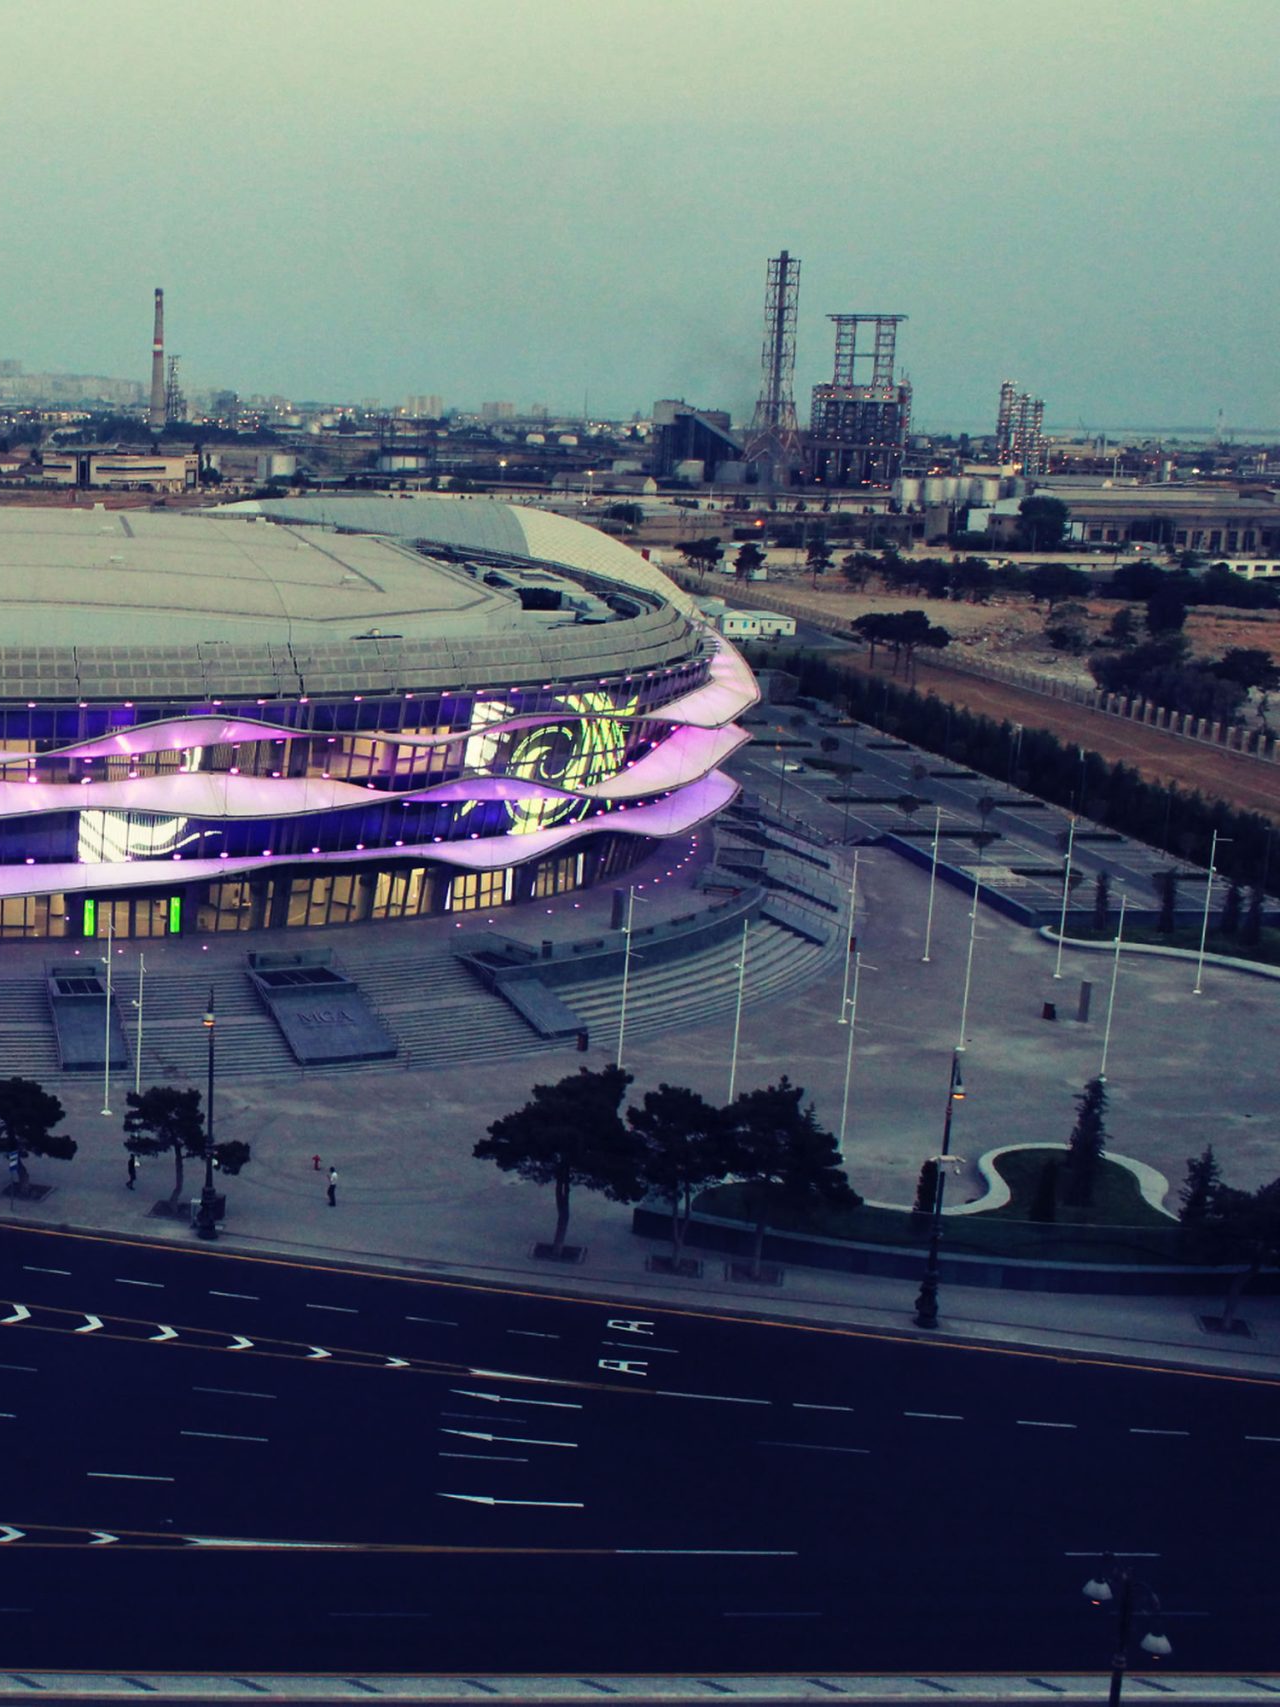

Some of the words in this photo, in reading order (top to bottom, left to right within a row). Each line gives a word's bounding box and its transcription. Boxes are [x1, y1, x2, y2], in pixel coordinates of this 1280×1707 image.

[296, 1009, 354, 1024] MGA
[607, 1319, 656, 1336] A
[598, 1359, 649, 1377] A
